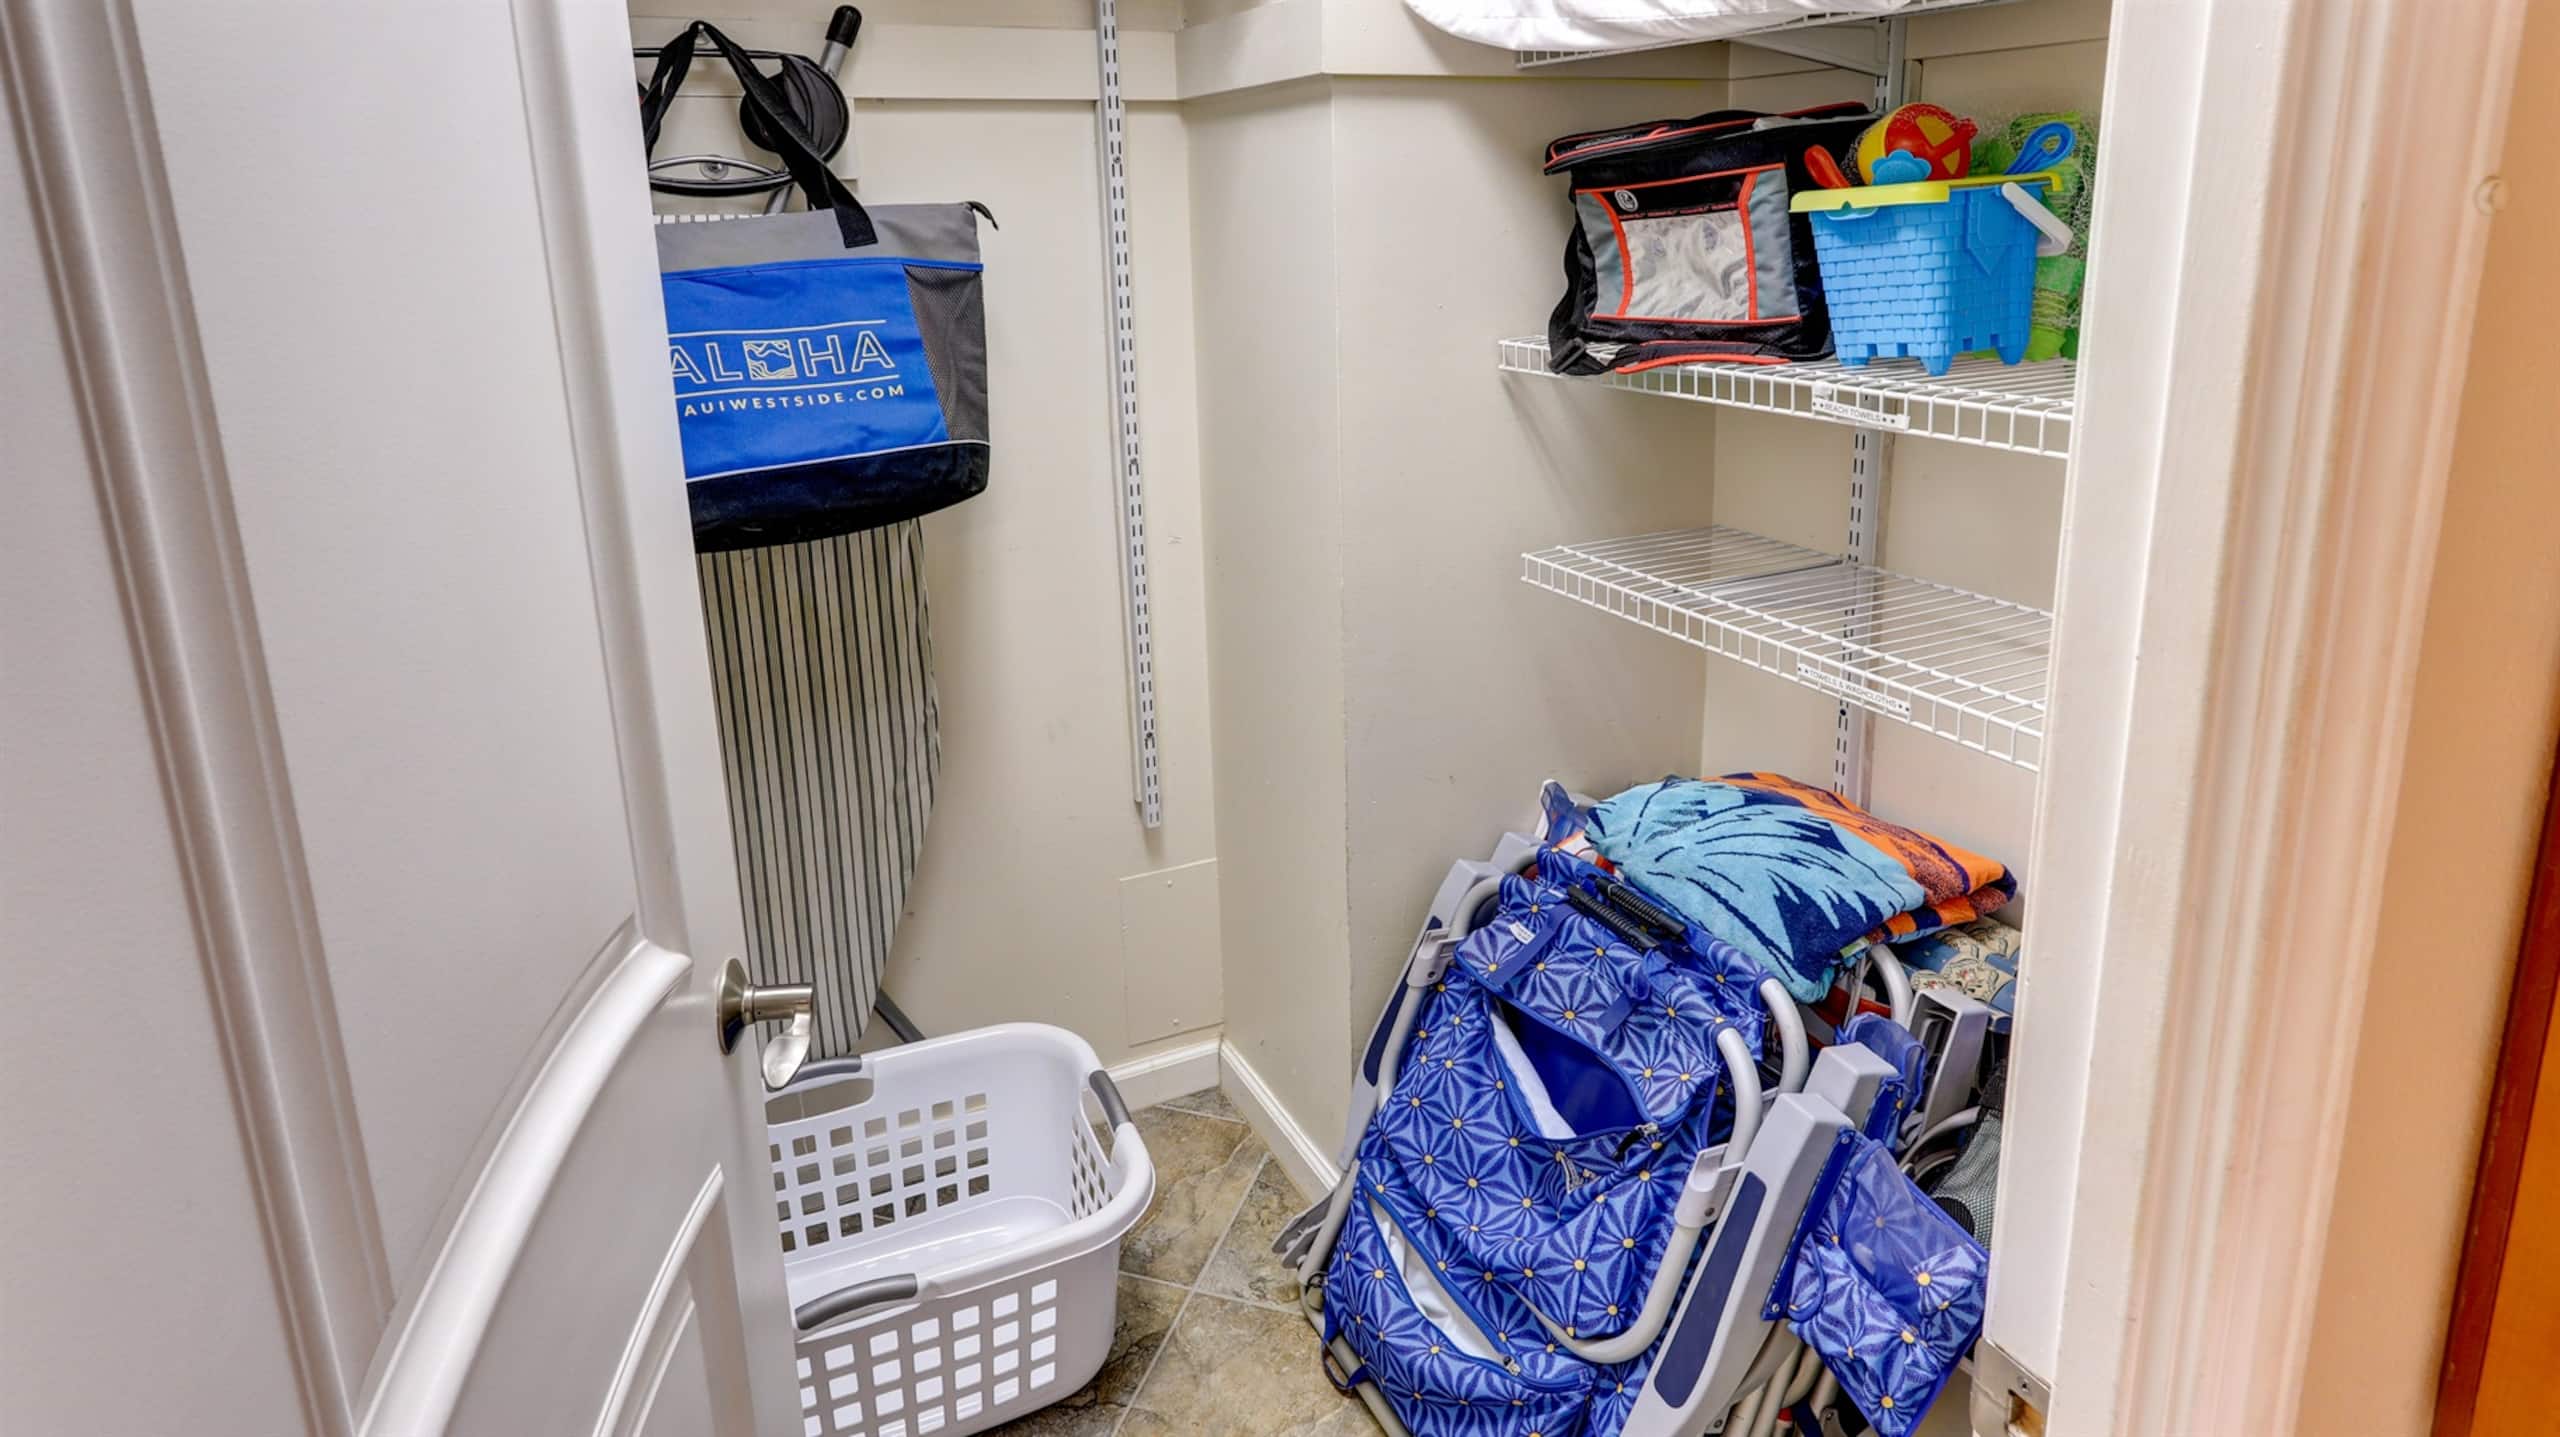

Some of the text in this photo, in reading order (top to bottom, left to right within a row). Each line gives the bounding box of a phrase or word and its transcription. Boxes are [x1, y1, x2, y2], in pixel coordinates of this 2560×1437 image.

[1825, 402, 1881, 422] BEACH TOWELS
[1809, 669, 1837, 685] TOWELS
